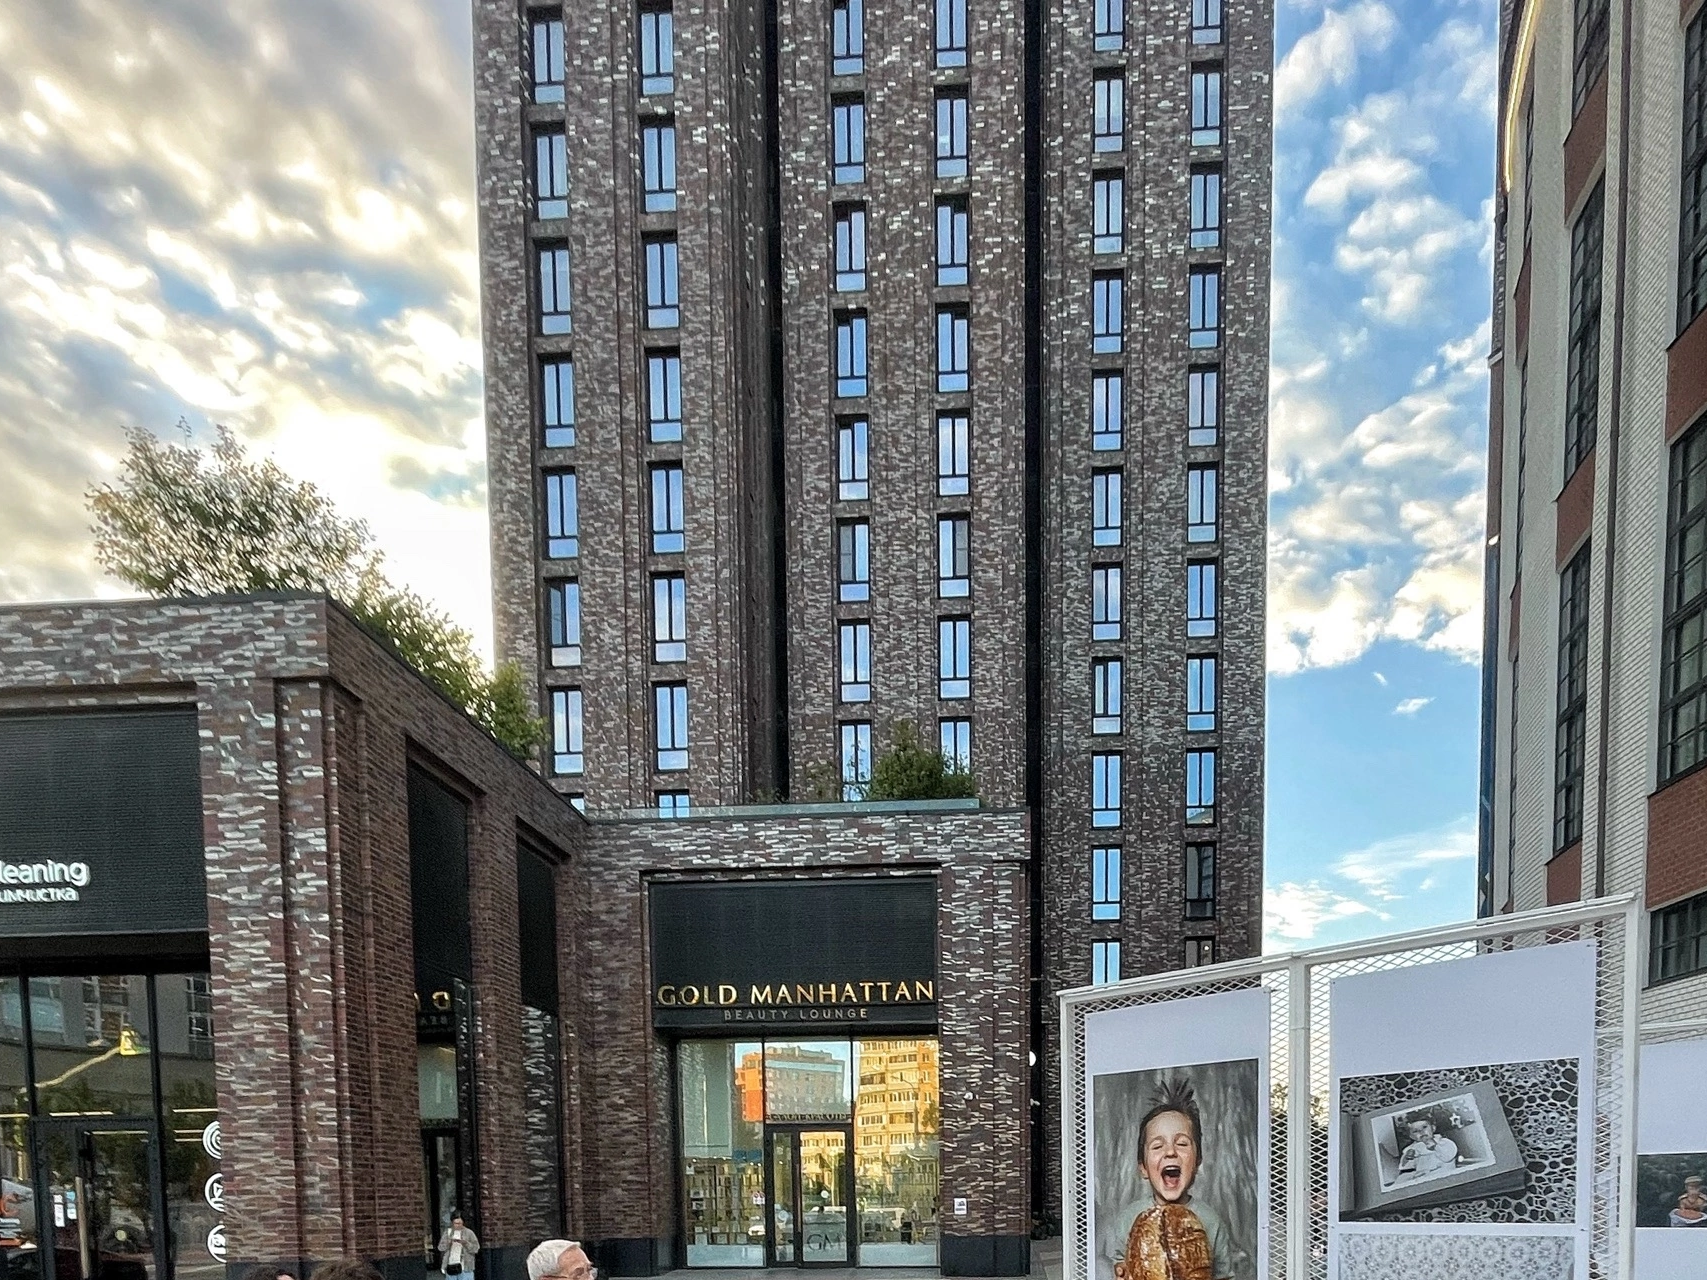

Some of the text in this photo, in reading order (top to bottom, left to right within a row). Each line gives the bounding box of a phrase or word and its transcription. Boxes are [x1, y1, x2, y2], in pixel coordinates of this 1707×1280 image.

[657, 981, 934, 1006] GOLD MANHATTAN
[723, 1008, 869, 1020] BEAUTY LOUNGE
